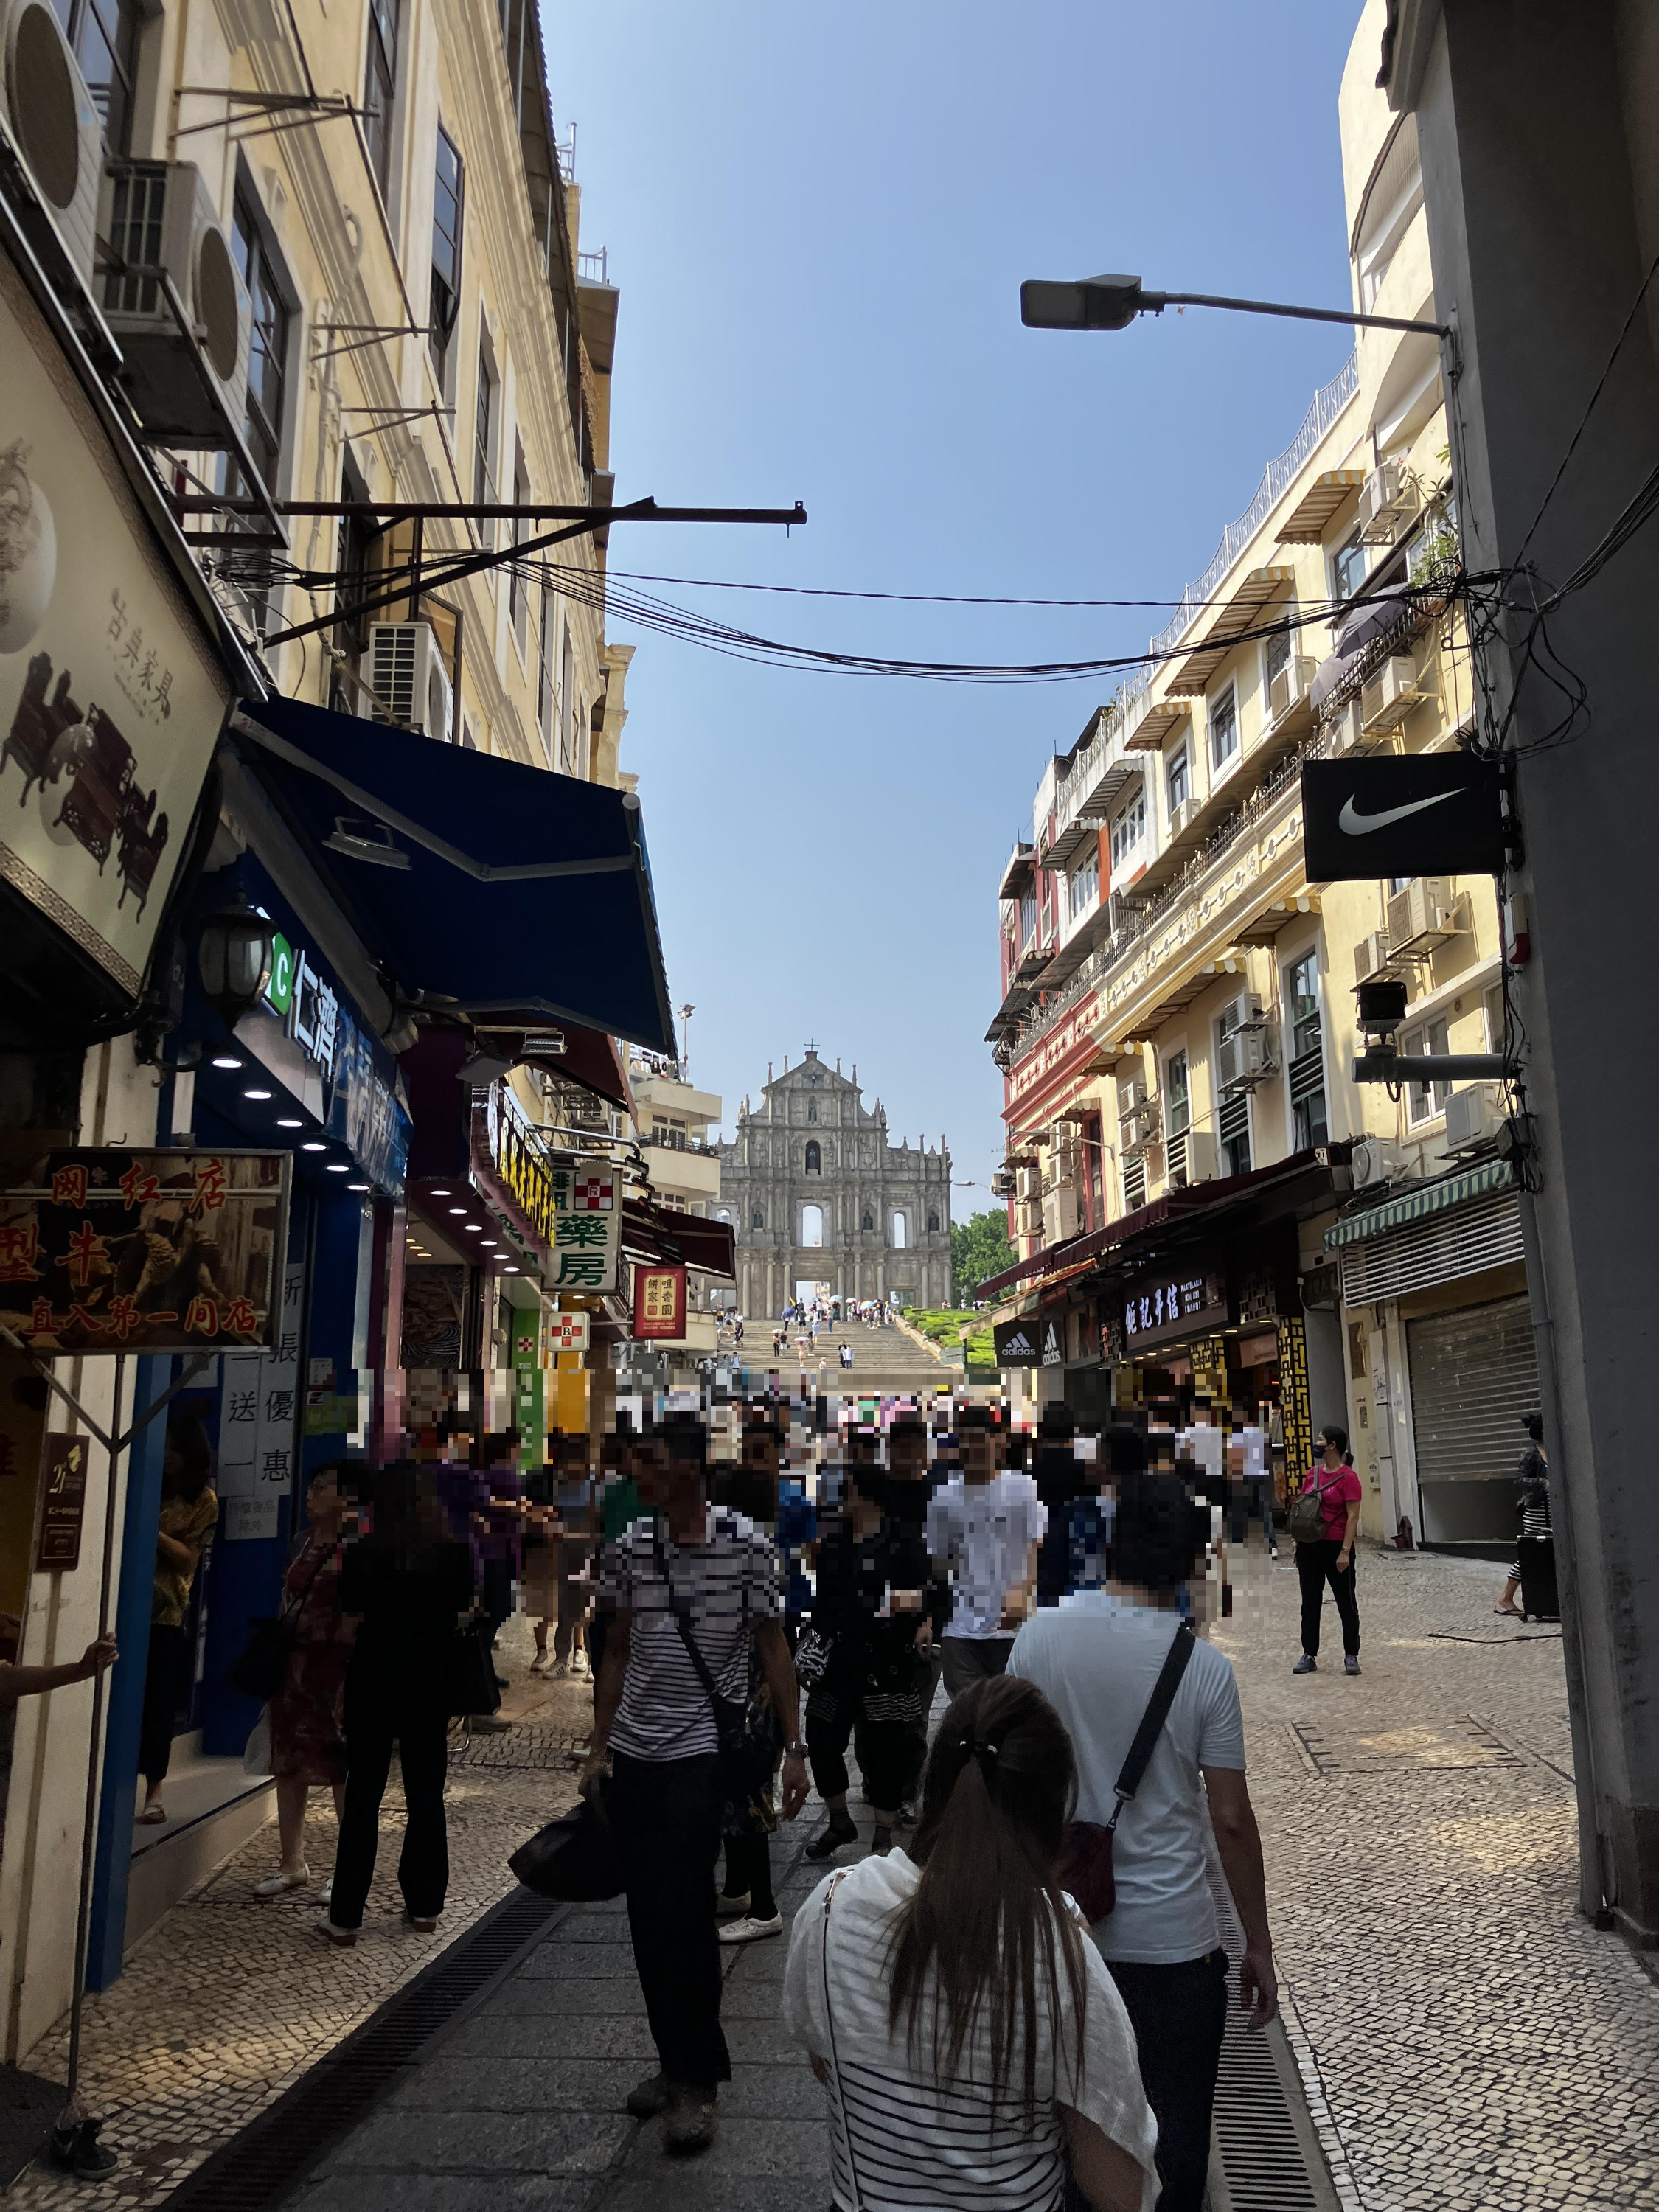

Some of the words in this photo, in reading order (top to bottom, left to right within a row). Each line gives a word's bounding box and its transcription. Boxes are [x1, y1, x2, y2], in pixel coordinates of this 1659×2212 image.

[276, 952, 288, 997] C
[51, 1158, 228, 1214] 网红店
[555, 1214, 608, 1286] 藥房
[647, 1278, 659, 1304] 餅家
[1001, 1347, 1036, 1356] adidas
[1043, 1348, 1060, 1366] adidas
